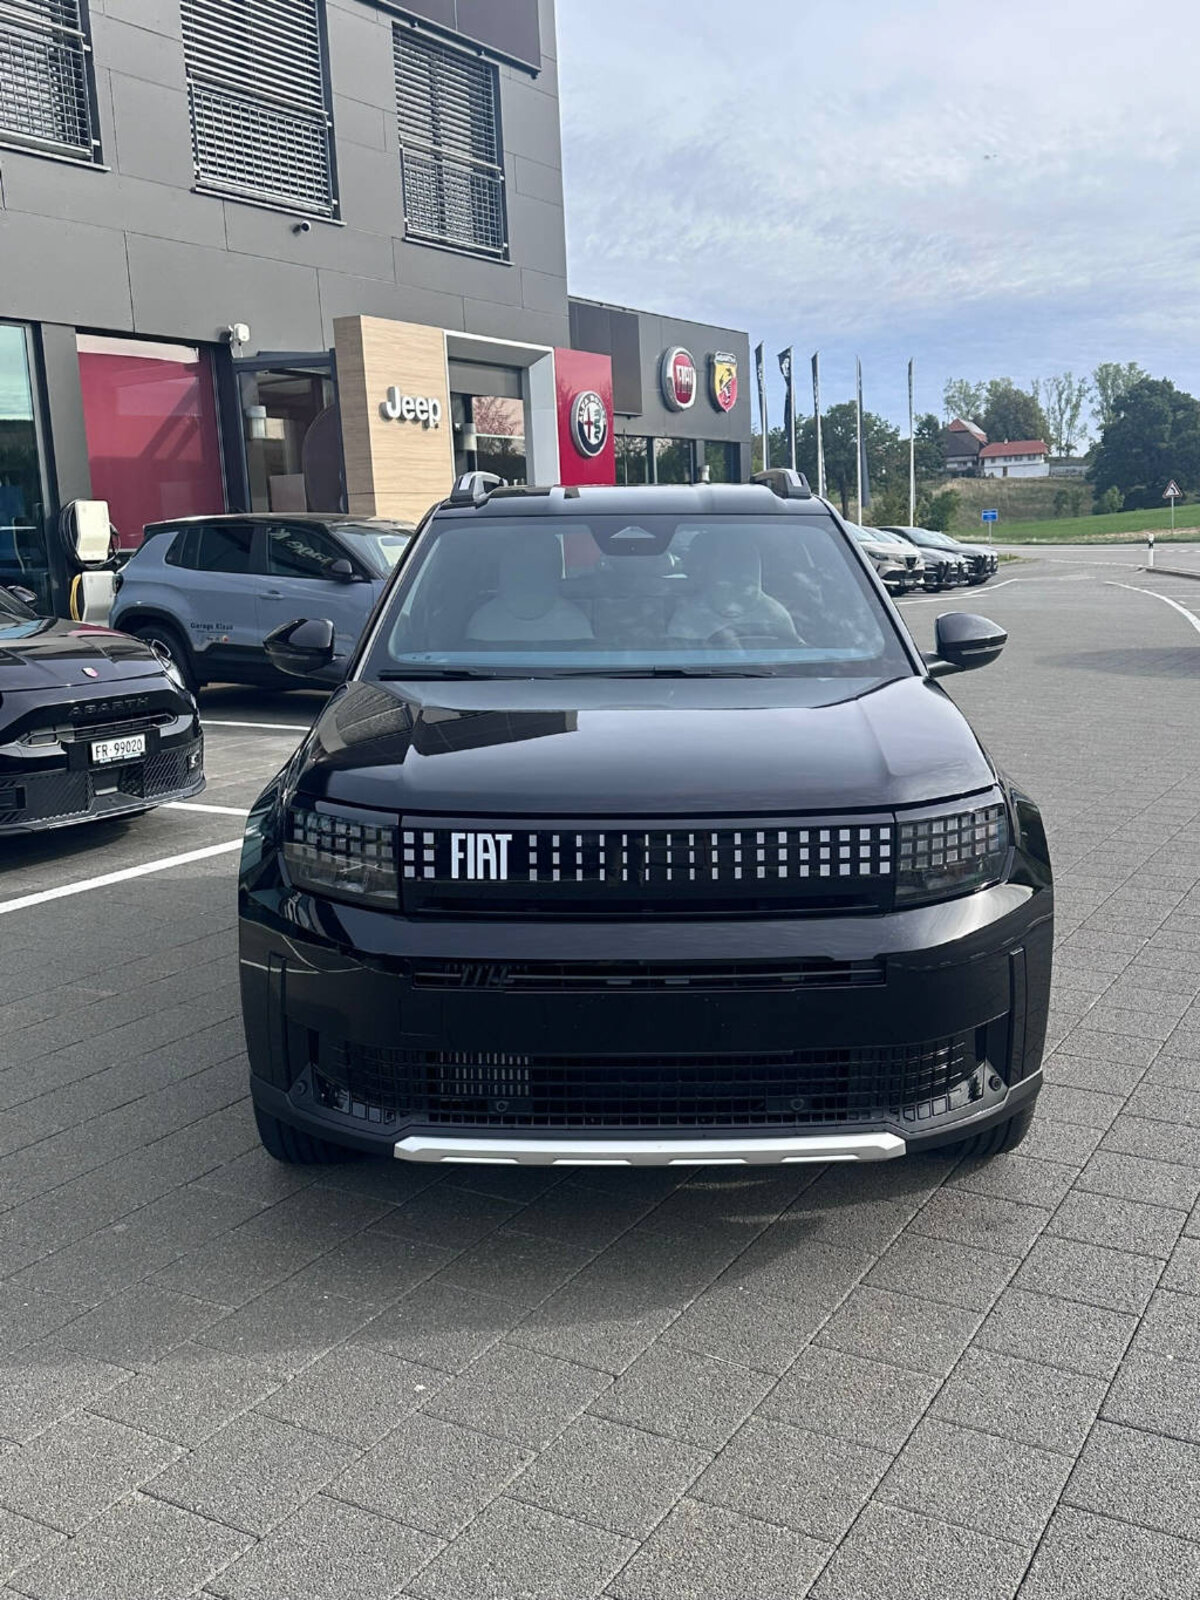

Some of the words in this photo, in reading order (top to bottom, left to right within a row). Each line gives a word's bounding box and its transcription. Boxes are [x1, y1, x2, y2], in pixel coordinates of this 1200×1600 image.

[381, 386, 441, 429] Jeep
[68, 696, 150, 716] ABARTH
[451, 832, 512, 880] FIAT
